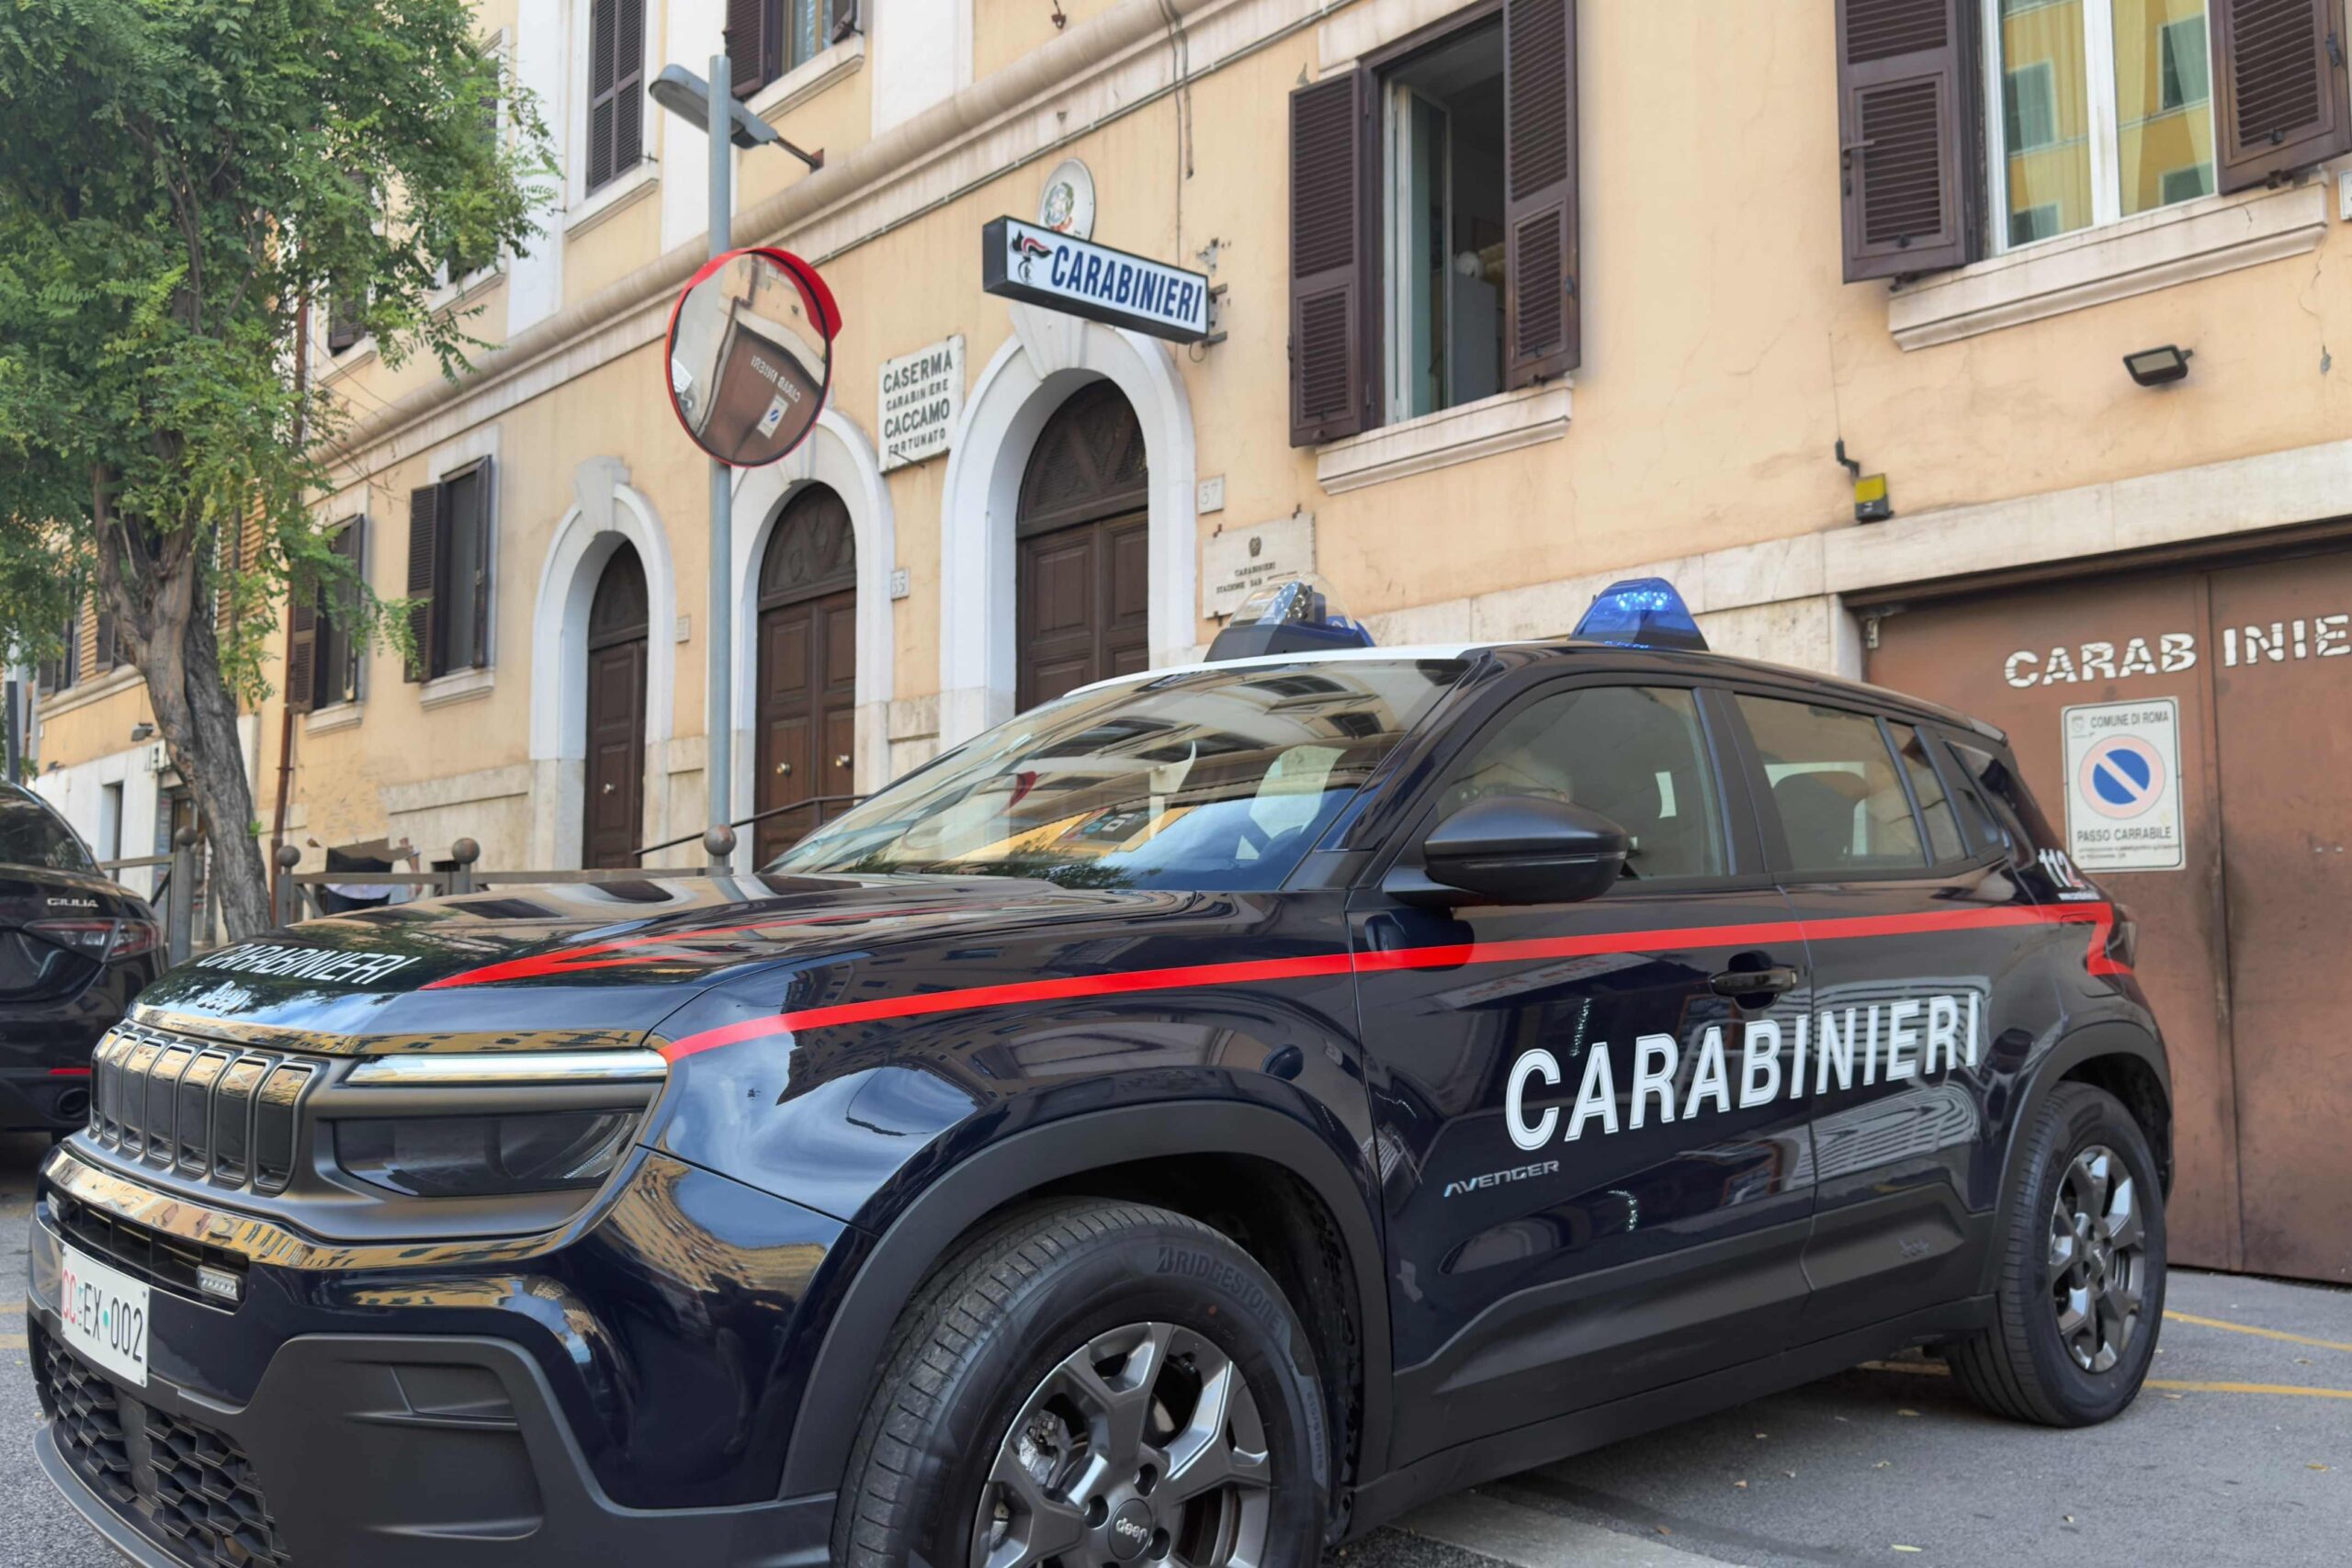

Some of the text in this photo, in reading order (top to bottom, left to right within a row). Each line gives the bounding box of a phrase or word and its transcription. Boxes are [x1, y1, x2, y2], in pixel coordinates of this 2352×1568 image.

[1051, 245, 1203, 323] CARABINIERI
[883, 349, 953, 393] CASERMA
[887, 378, 948, 412] CARABINERE
[884, 398, 950, 439] CACCAMO
[888, 428, 945, 457] FORTUNATO
[2090, 711, 2168, 728] COMUNE DI ROMA
[2077, 826, 2172, 842] PASSO CARRABILE
[2038, 848, 2086, 888] 112
[47, 897, 99, 908] GIULIA
[196, 942, 423, 986] CARABINIERI
[1505, 991, 1980, 1151] CARABINIERI
[1443, 1160, 1560, 1197] AVENGER
[62, 1269, 77, 1324] CC
[1155, 1246, 1283, 1329] BRIDGESTONE
[1115, 1517, 1148, 1544] Jeep
